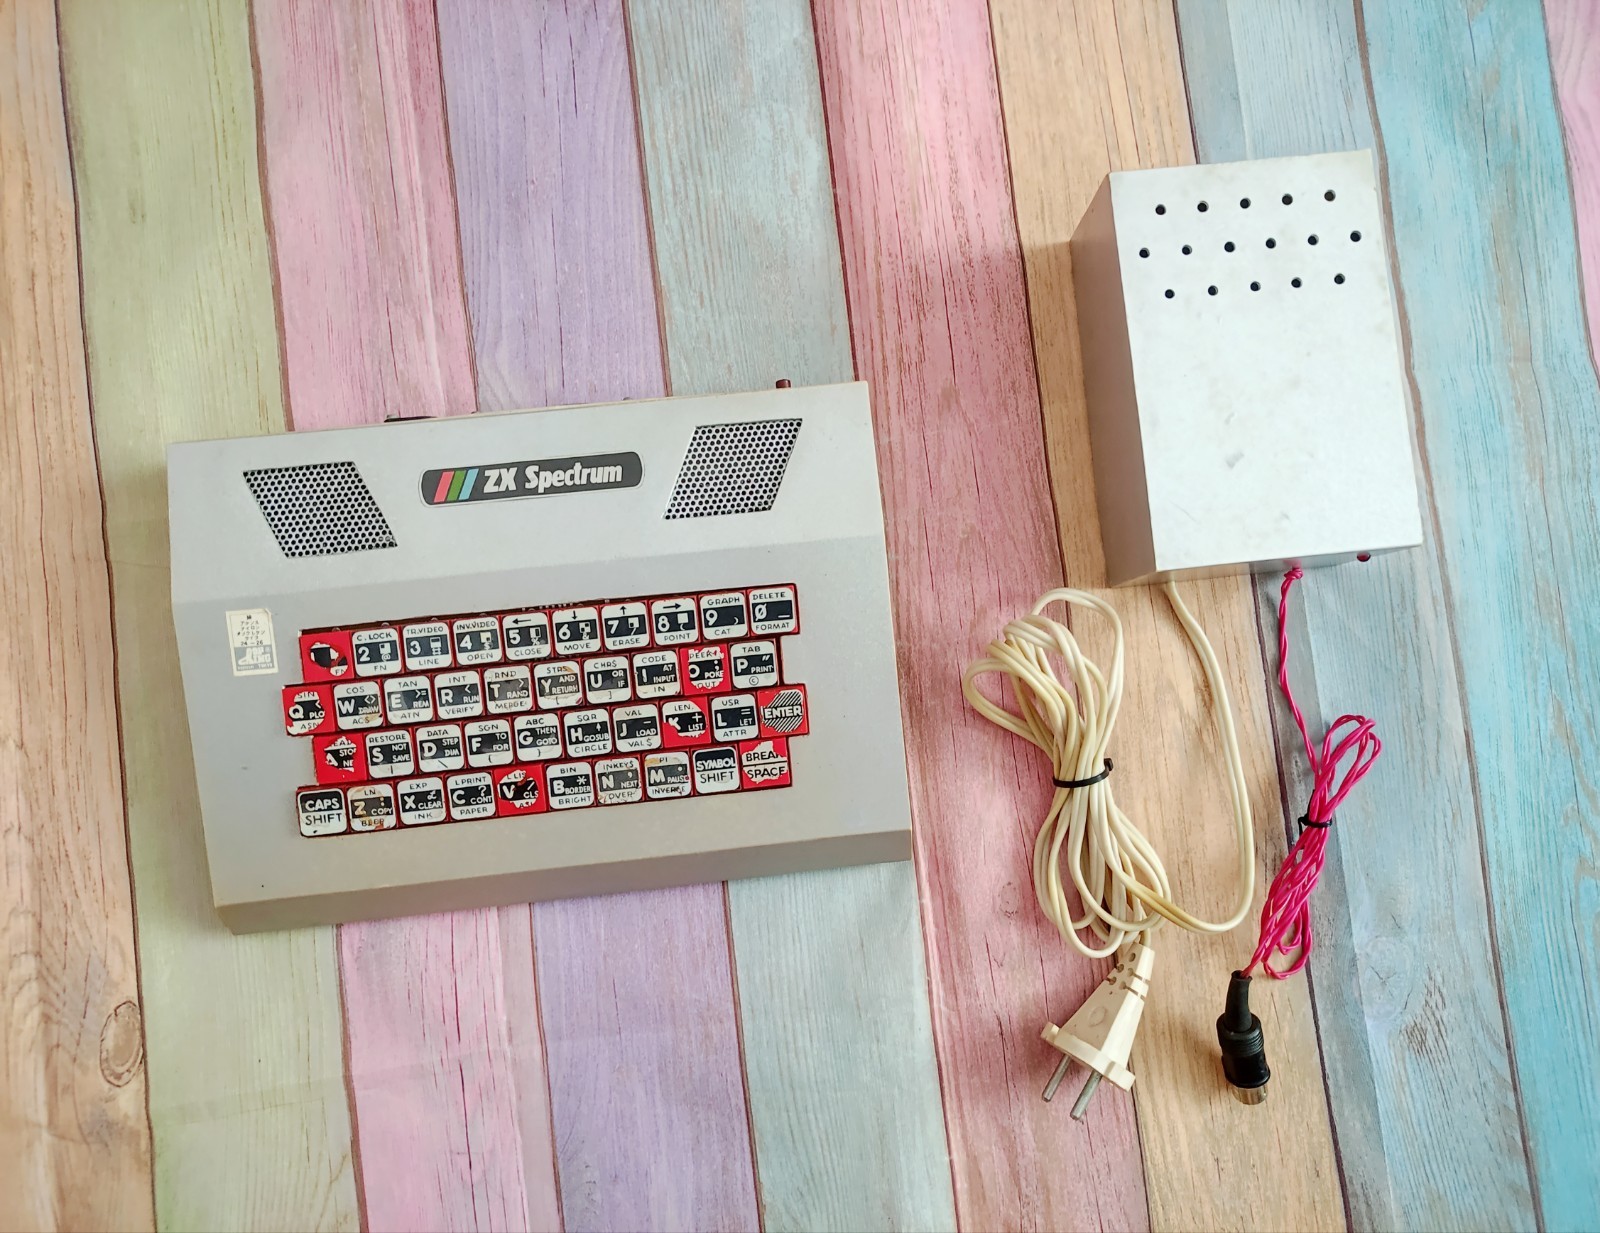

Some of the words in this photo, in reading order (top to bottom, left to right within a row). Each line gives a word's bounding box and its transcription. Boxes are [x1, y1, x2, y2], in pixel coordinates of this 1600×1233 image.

[483, 467, 518, 494] ZX
[524, 462, 623, 493] Spectrum
[708, 597, 740, 605] GRAPH
[753, 592, 786, 600] DELETE
[706, 610, 718, 626] 9
[608, 619, 619, 634] 7
[658, 616, 670, 631] 8
[756, 623, 790, 631] FORMAT
[509, 629, 521, 645] 5
[558, 624, 571, 640] 6
[664, 633, 691, 641] POINT
[714, 628, 730, 636] CAT
[460, 635, 472, 650] 4
[612, 637, 641, 646] ERASE
[410, 641, 421, 655] 3
[514, 648, 542, 656] CLOSE
[563, 643, 591, 651] MOVE
[358, 647, 370, 662] 2
[467, 653, 493, 661] OPEN
[642, 655, 667, 663] CODE
[737, 658, 748, 673] P
[653, 675, 675, 683] INPUT
[705, 671, 724, 679] POKE
[541, 679, 552, 693] Y
[590, 674, 602, 688] U
[347, 686, 364, 694] COS
[490, 684, 500, 698] T
[507, 690, 528, 698] RAND
[552, 685, 578, 694] RETURN
[391, 694, 402, 708] E
[441, 689, 453, 704] R
[338, 699, 355, 714] W
[445, 706, 475, 715] VERIFY
[289, 705, 304, 719] Q
[309, 711, 326, 719] PLO
[763, 706, 802, 718] ENTER
[352, 717, 370, 725] ACS
[526, 718, 544, 726] ABC
[577, 714, 597, 722] SQR
[717, 713, 728, 727] L
[740, 718, 752, 726] LET
[478, 724, 498, 732] SGN
[668, 717, 681, 730] K
[688, 723, 703, 731] LIST
[535, 727, 556, 735] THEN
[570, 728, 583, 742] H
[619, 723, 628, 737] J
[369, 734, 406, 743] RESTORE
[495, 732, 506, 740] TO
[518, 731, 533, 746] G
[583, 732, 609, 742] GOSUB
[471, 737, 482, 752] F
[493, 743, 509, 751] FOR
[536, 738, 557, 746] GOTO
[423, 744, 437, 757] D
[442, 738, 458, 746] STEP
[574, 743, 608, 753] CIRCLE
[372, 749, 383, 763] S
[392, 743, 407, 751] NOT
[392, 754, 410, 762] SAVE
[746, 751, 780, 761] BREA
[696, 757, 736, 770] SYMBOL
[650, 769, 664, 784] M
[700, 771, 734, 783] SHIFT
[747, 767, 786, 778] SPACE
[602, 774, 614, 789] N
[620, 780, 638, 788] NEXT
[502, 785, 516, 799] V
[553, 780, 565, 794] B
[564, 785, 591, 795] BORDER
[452, 790, 465, 805] C
[470, 795, 492, 804] CONT
[523, 791, 538, 799] CLS
[305, 798, 340, 811] CAPS
[403, 795, 416, 810] X
[418, 800, 442, 810] CLEAR
[558, 796, 591, 805] BRIGHT
[354, 802, 366, 815] Z
[460, 807, 488, 815] PAPER
[305, 813, 342, 826] SHIFT
